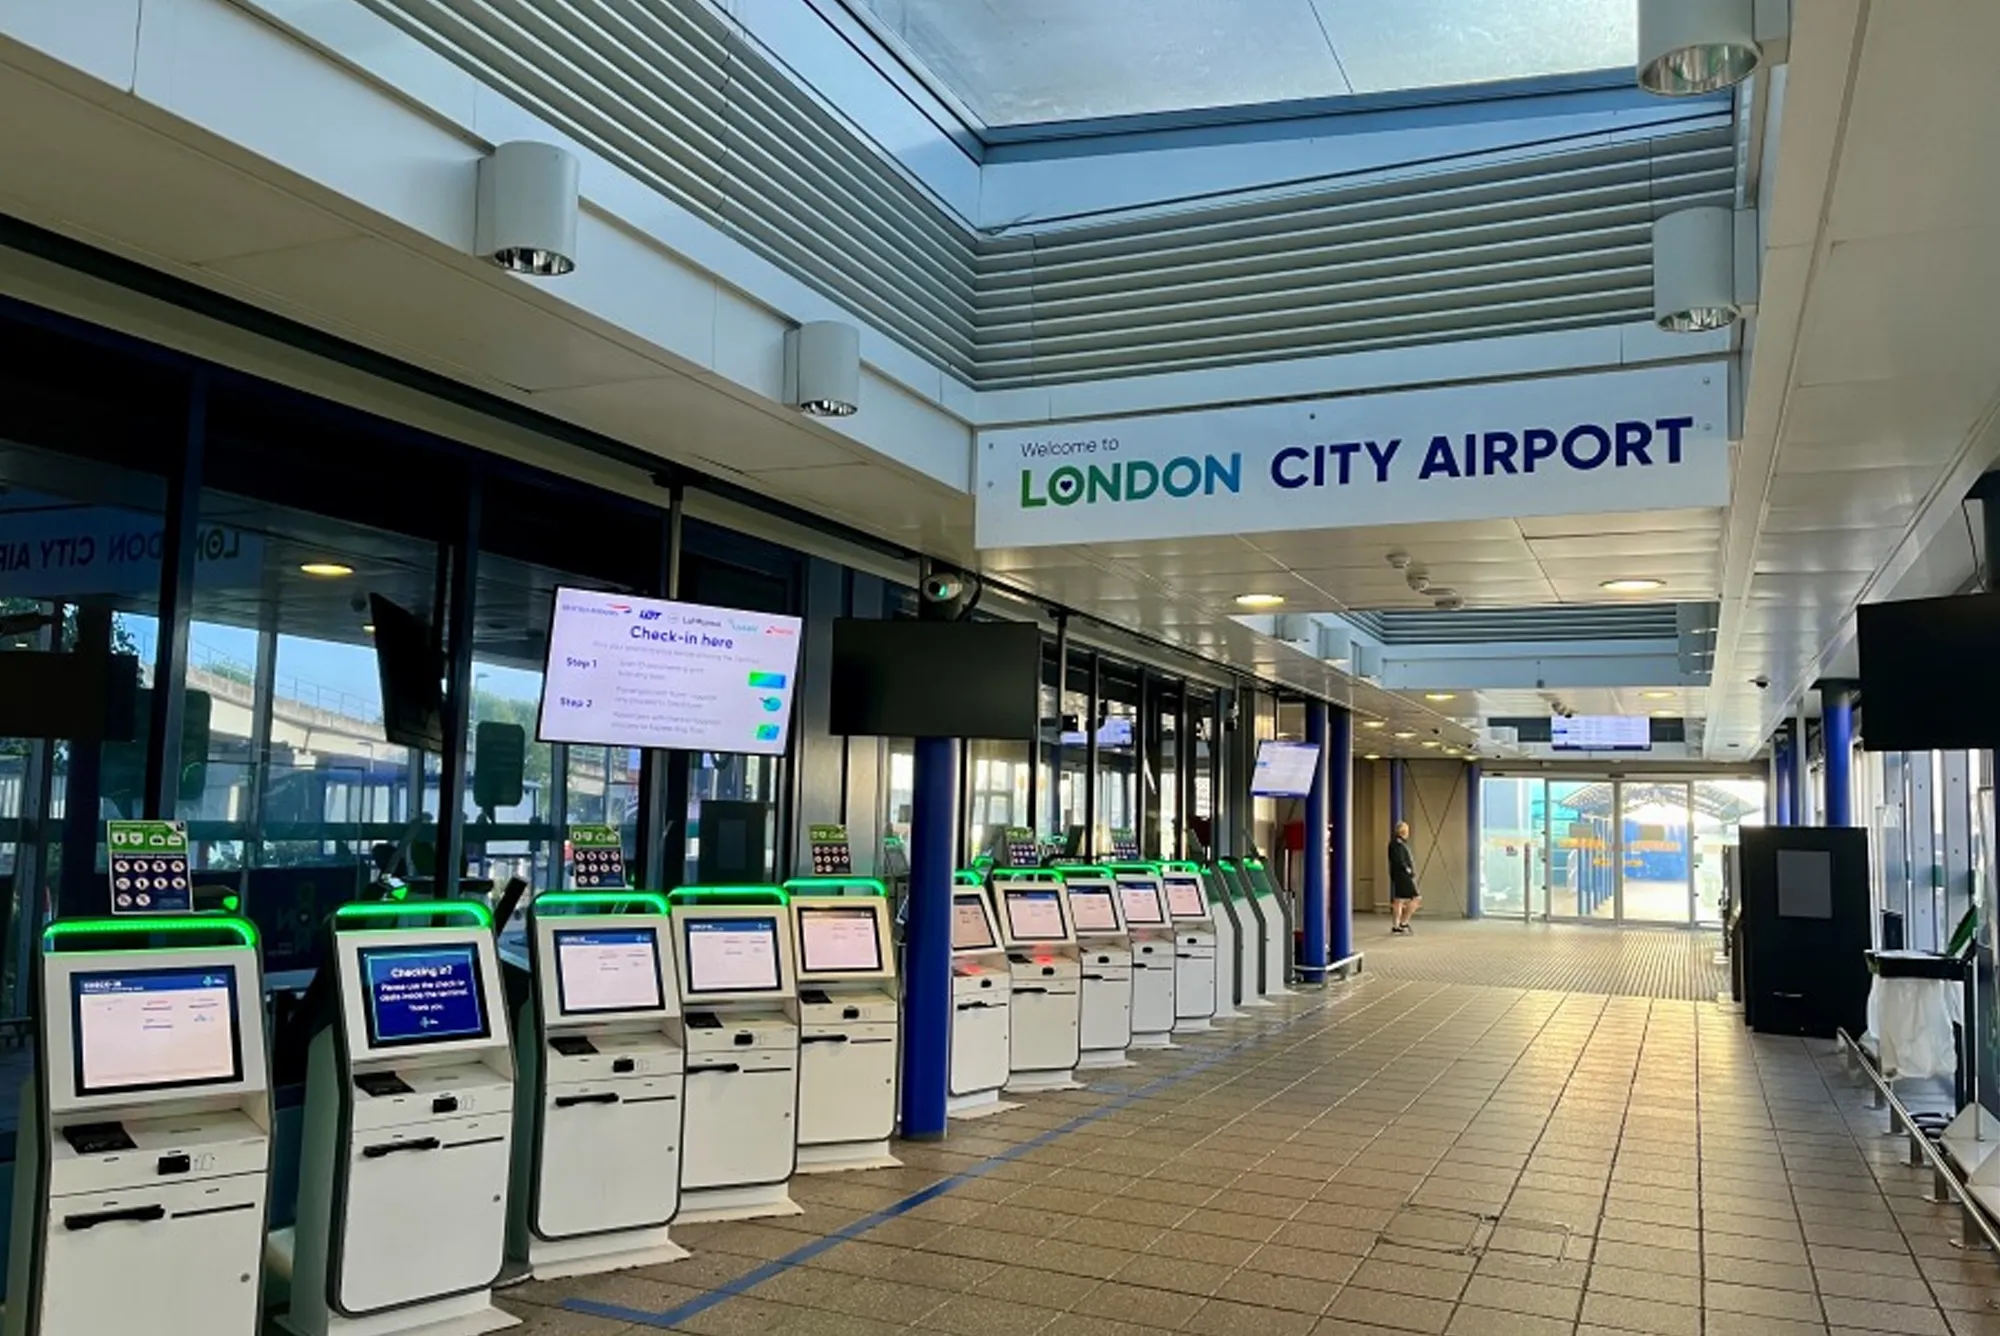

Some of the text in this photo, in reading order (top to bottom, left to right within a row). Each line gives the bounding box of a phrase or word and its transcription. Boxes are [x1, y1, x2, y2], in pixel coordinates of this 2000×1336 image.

[1021, 437, 1119, 458] Welcome to
[1021, 416, 1693, 508] LONDON CITY AIRPORT
[630, 625, 733, 649] Check-in here
